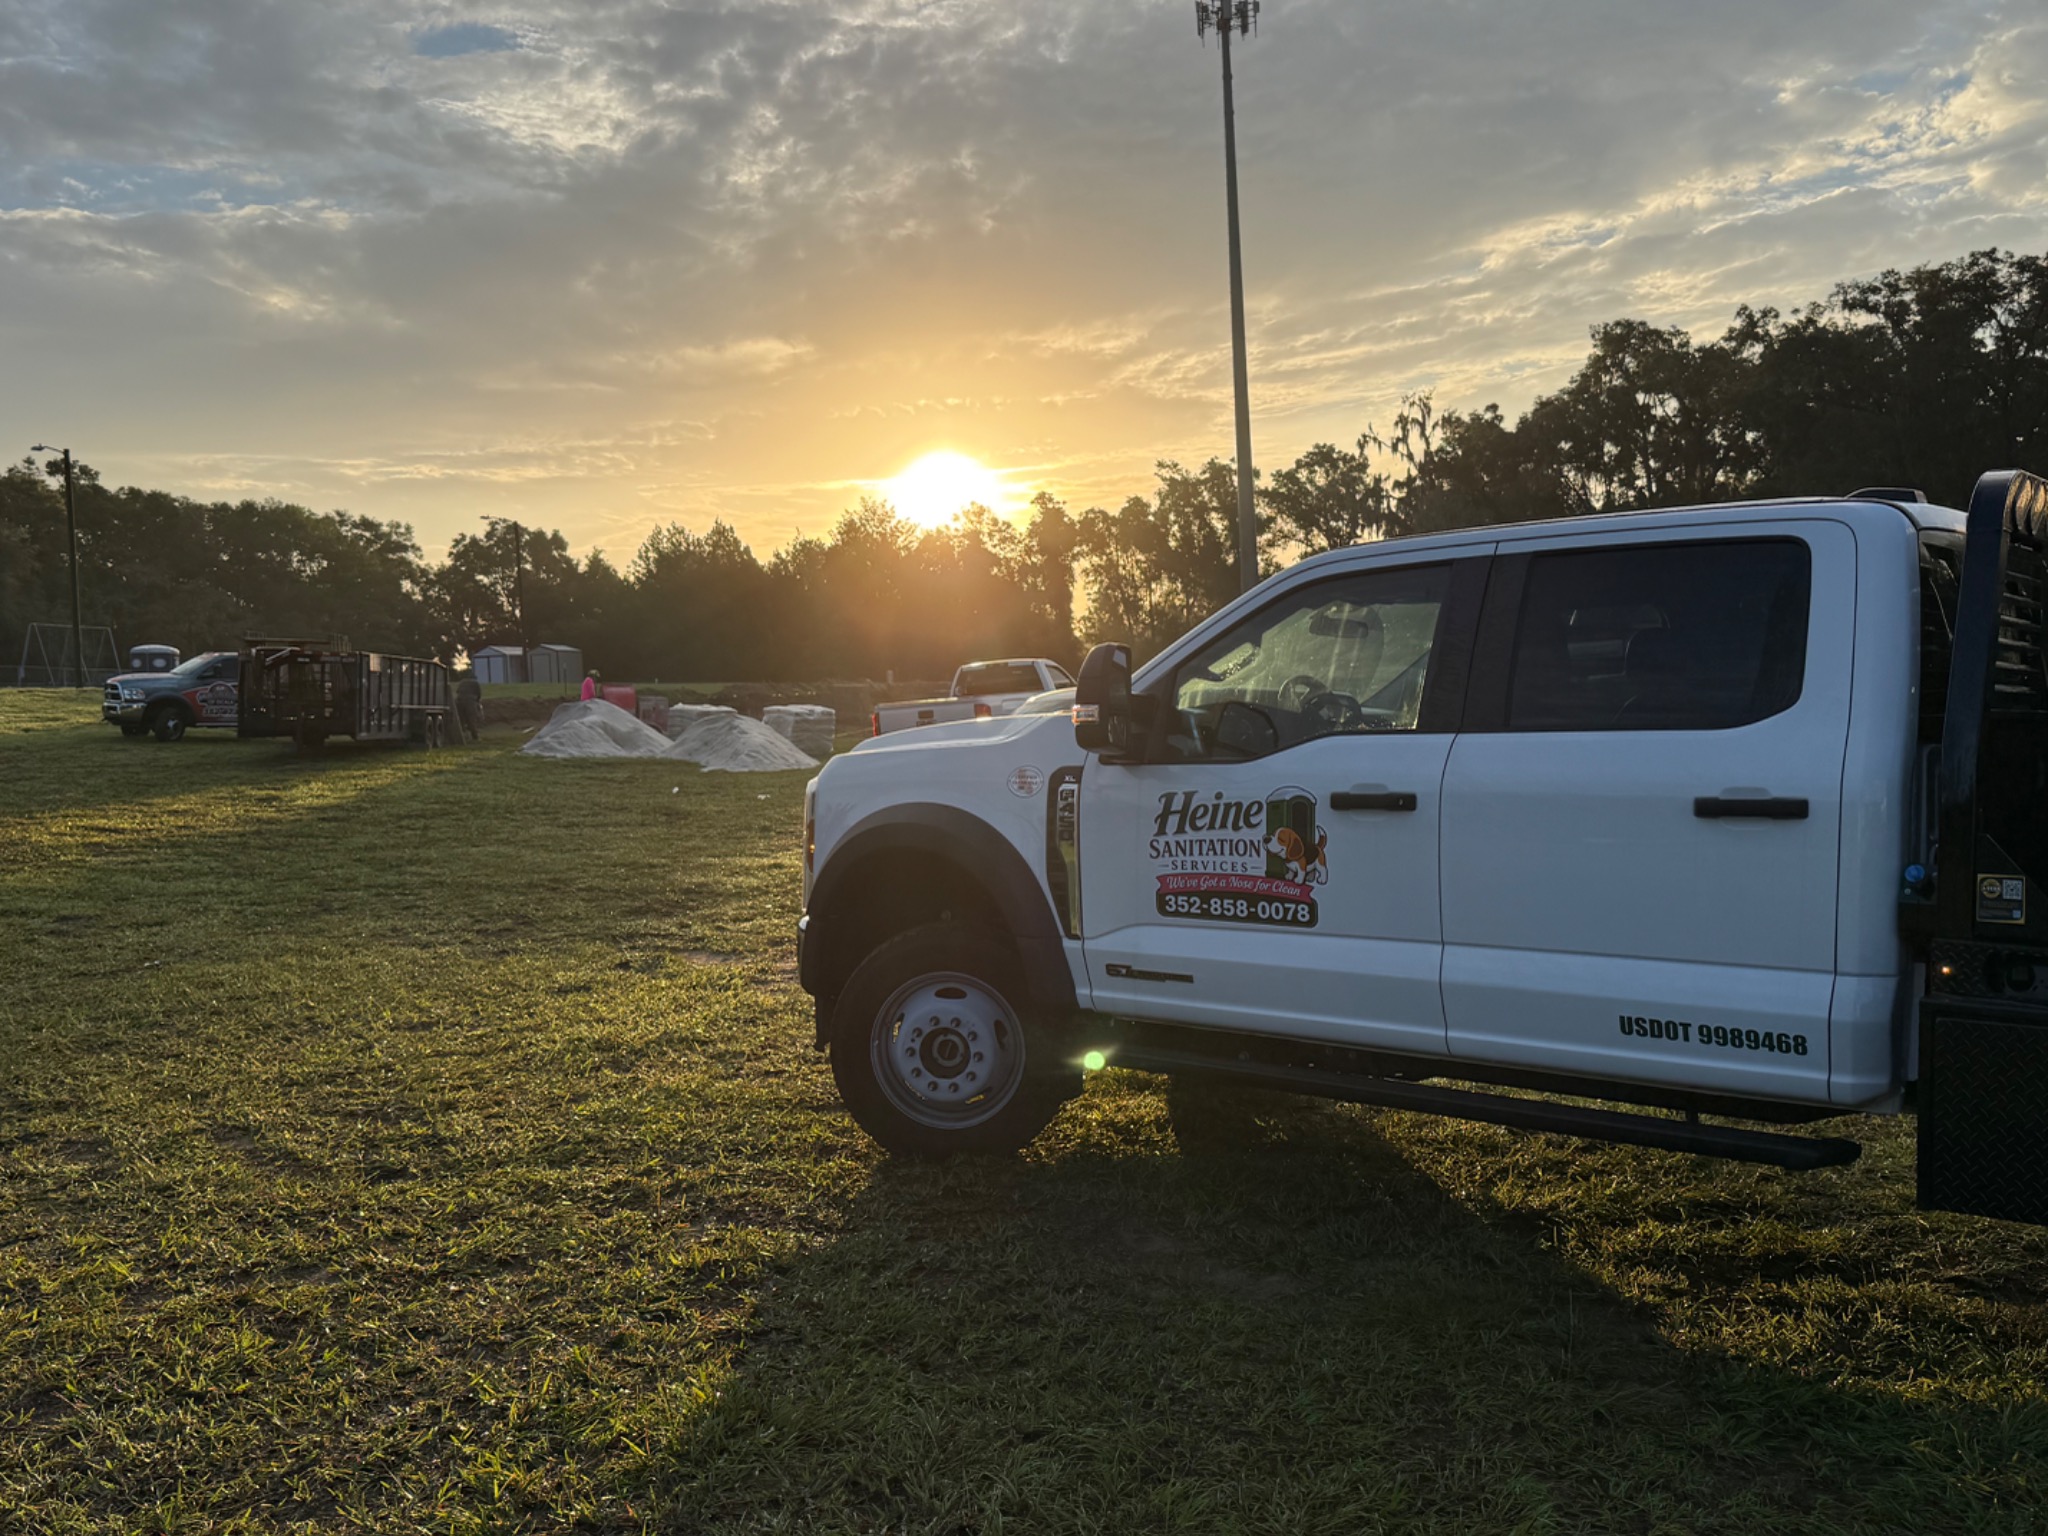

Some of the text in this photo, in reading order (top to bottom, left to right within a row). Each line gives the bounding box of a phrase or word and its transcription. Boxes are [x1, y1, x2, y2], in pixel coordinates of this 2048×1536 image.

[1153, 790, 1264, 837] Heine
[1150, 838, 1261, 859] SANITATION
[1171, 860, 1248, 873] SERVICES
[1166, 876, 1198, 889] We've
[1200, 875, 1217, 890] Got
[1229, 876, 1253, 889] Nose
[1253, 879, 1270, 893] for
[1271, 880, 1301, 896] Clean
[1165, 895, 1311, 922] 352-858-0078
[1619, 1015, 1808, 1056] USDOT 9989468
